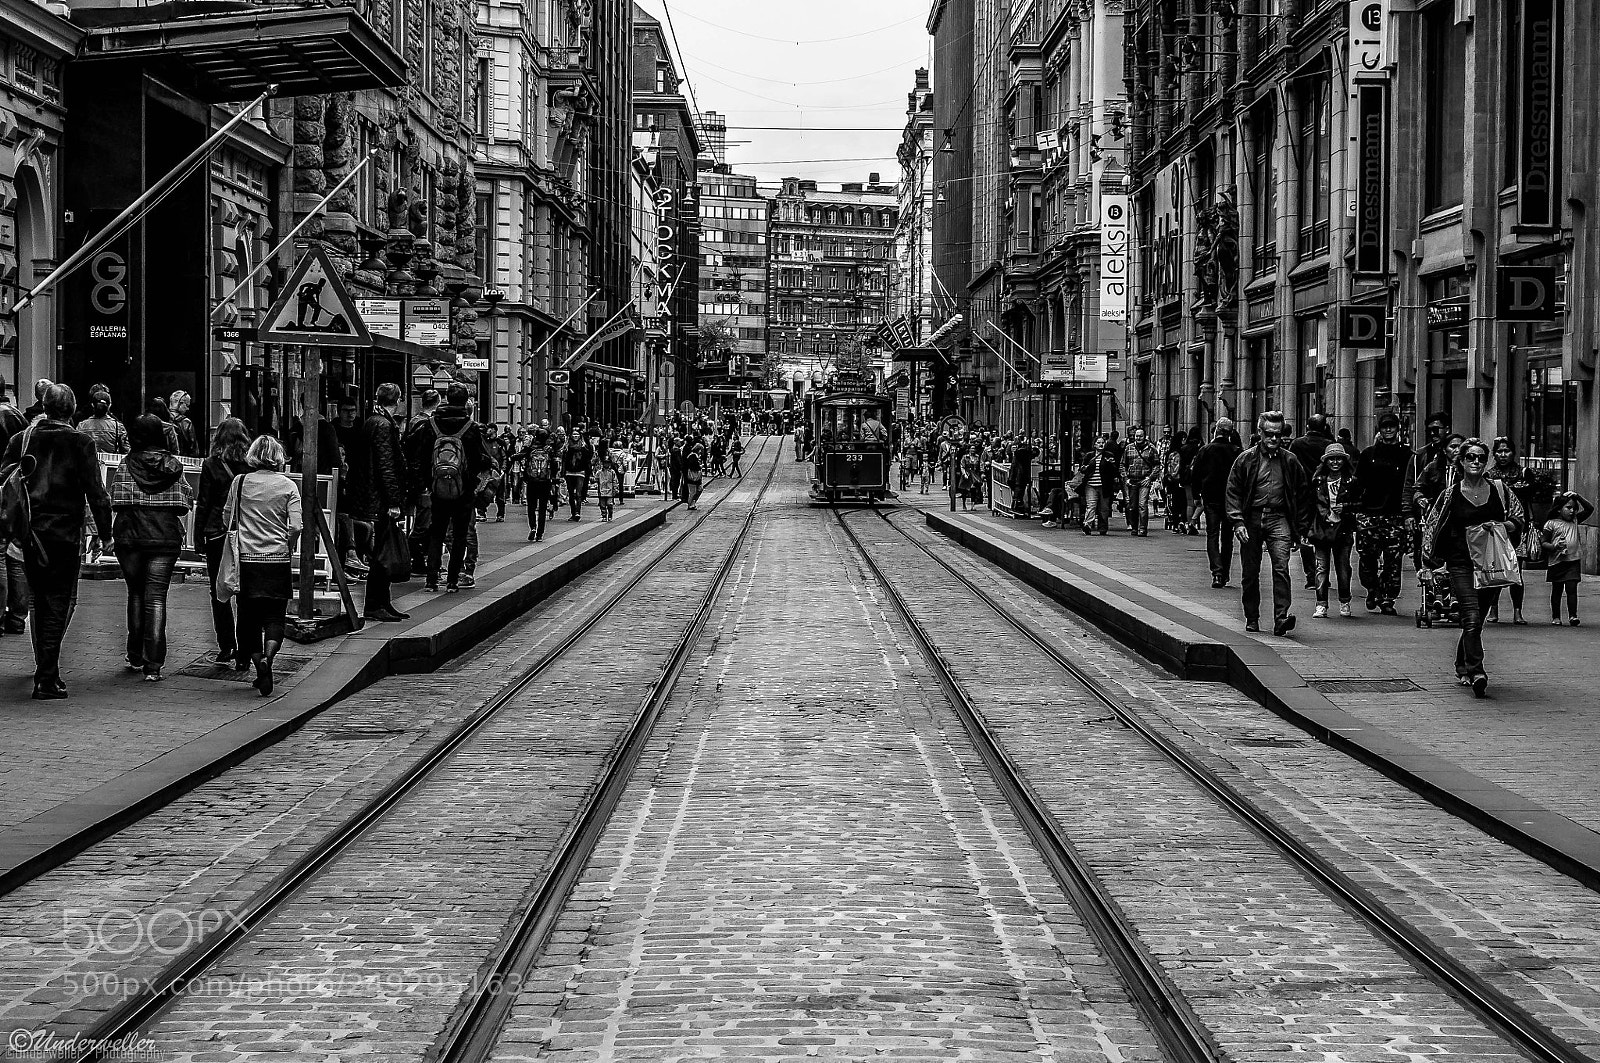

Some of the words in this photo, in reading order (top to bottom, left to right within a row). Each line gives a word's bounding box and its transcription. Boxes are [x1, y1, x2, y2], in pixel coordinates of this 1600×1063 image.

[1525, 18, 1549, 193] Dressmann
[1361, 112, 1379, 248] Dressmann
[1102, 224, 1125, 296] aleksi
[846, 454, 863, 462] 233
